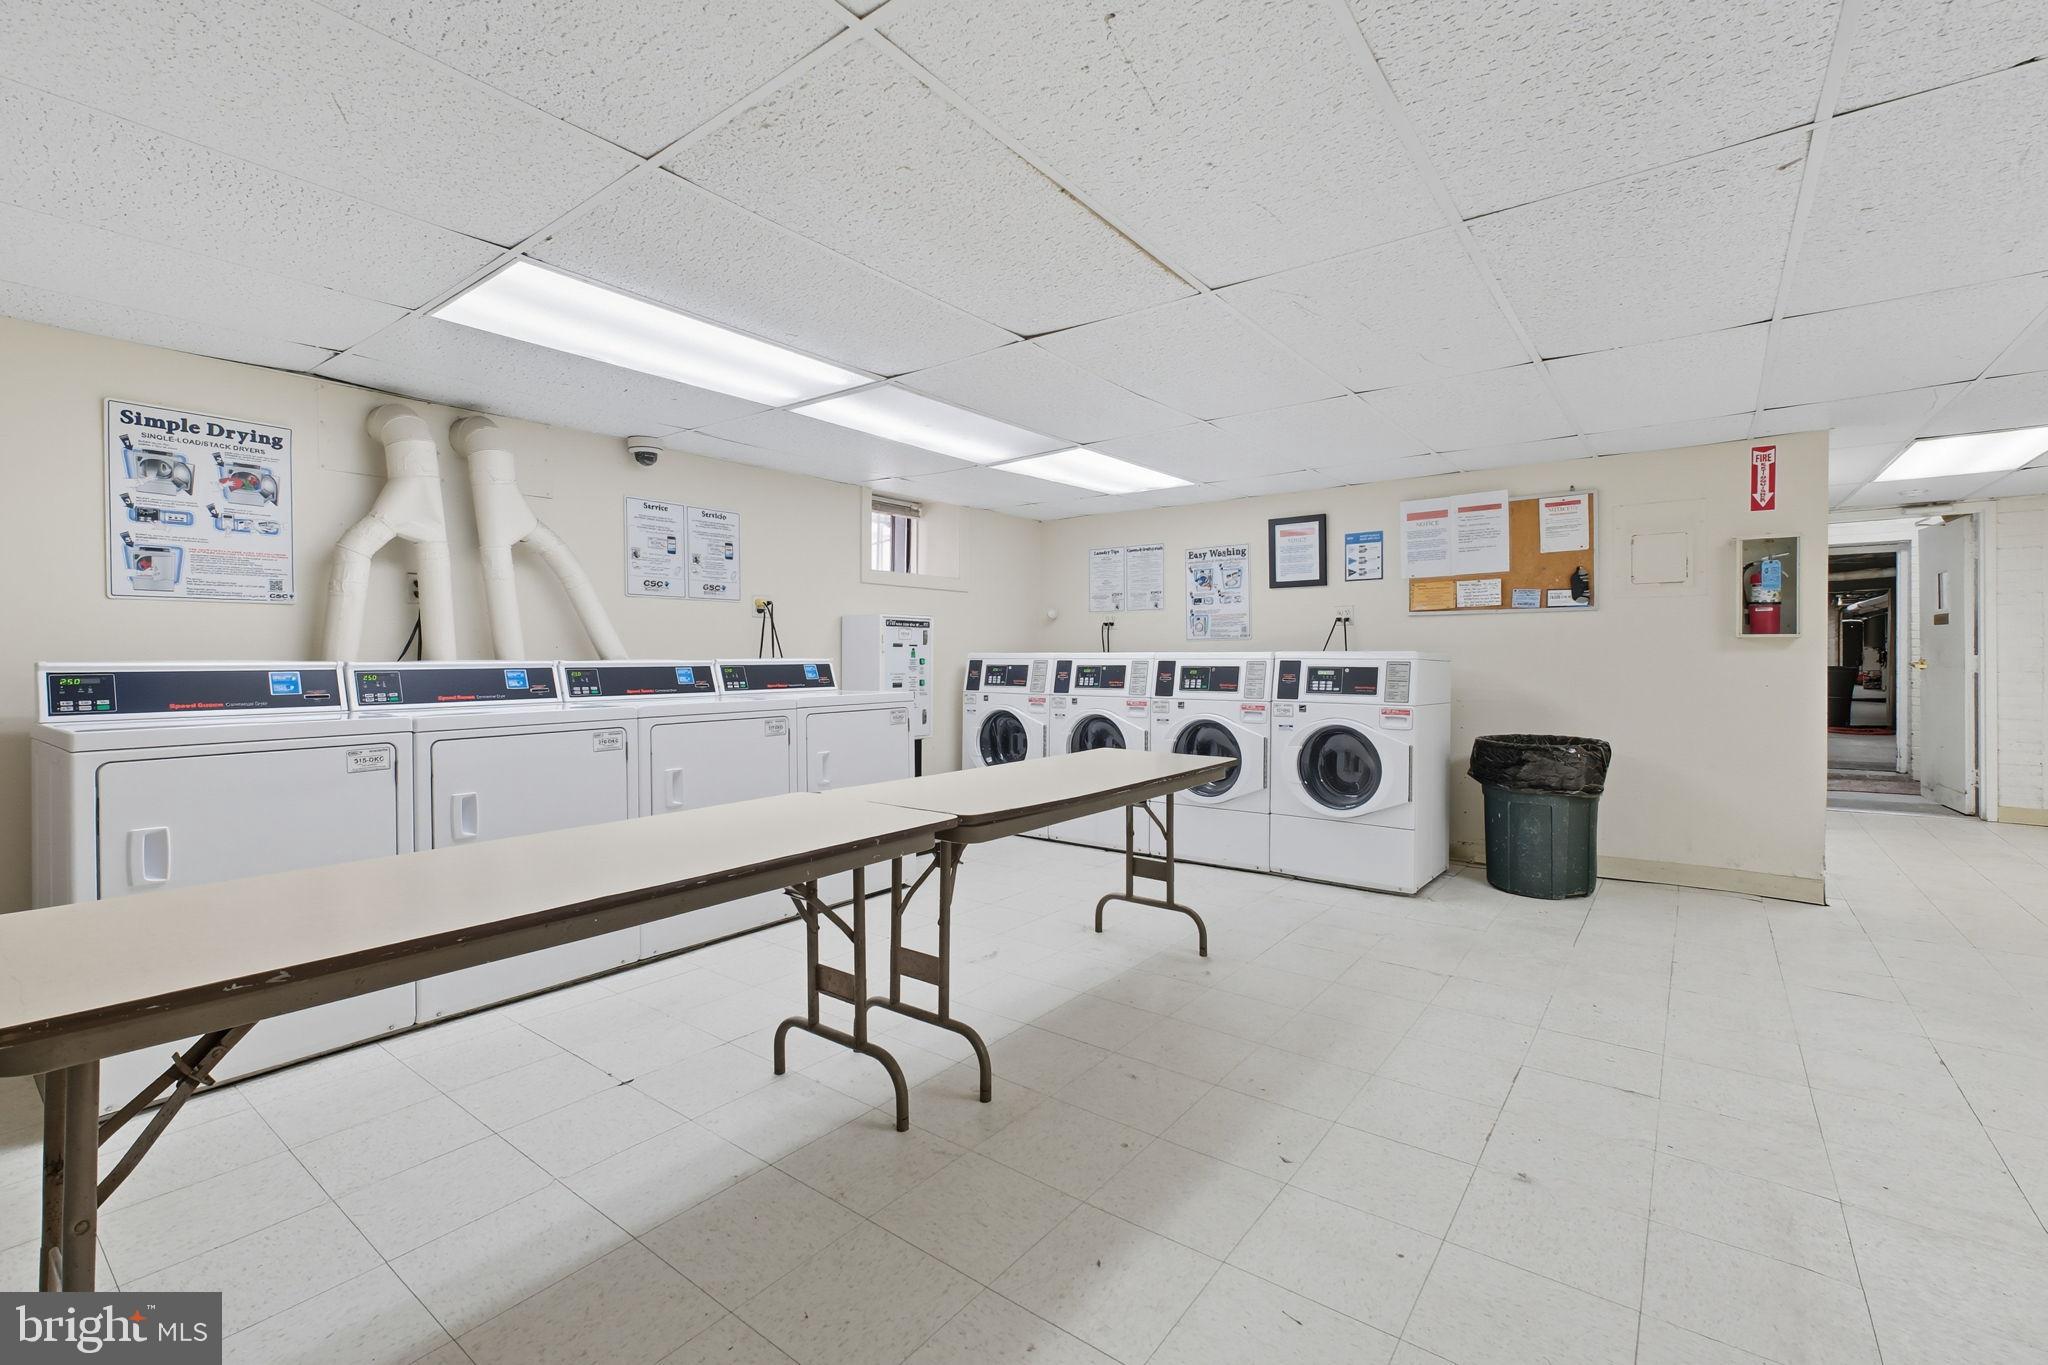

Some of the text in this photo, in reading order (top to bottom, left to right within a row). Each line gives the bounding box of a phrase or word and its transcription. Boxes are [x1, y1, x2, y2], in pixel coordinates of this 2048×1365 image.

[120, 409, 283, 450] Simple Drying
[233, 444, 266, 455] DRYERS
[1755, 453, 1772, 463] FIRE
[643, 502, 669, 512] Service
[701, 510, 727, 520] Servicio
[1188, 547, 1247, 560] Easy Washing
